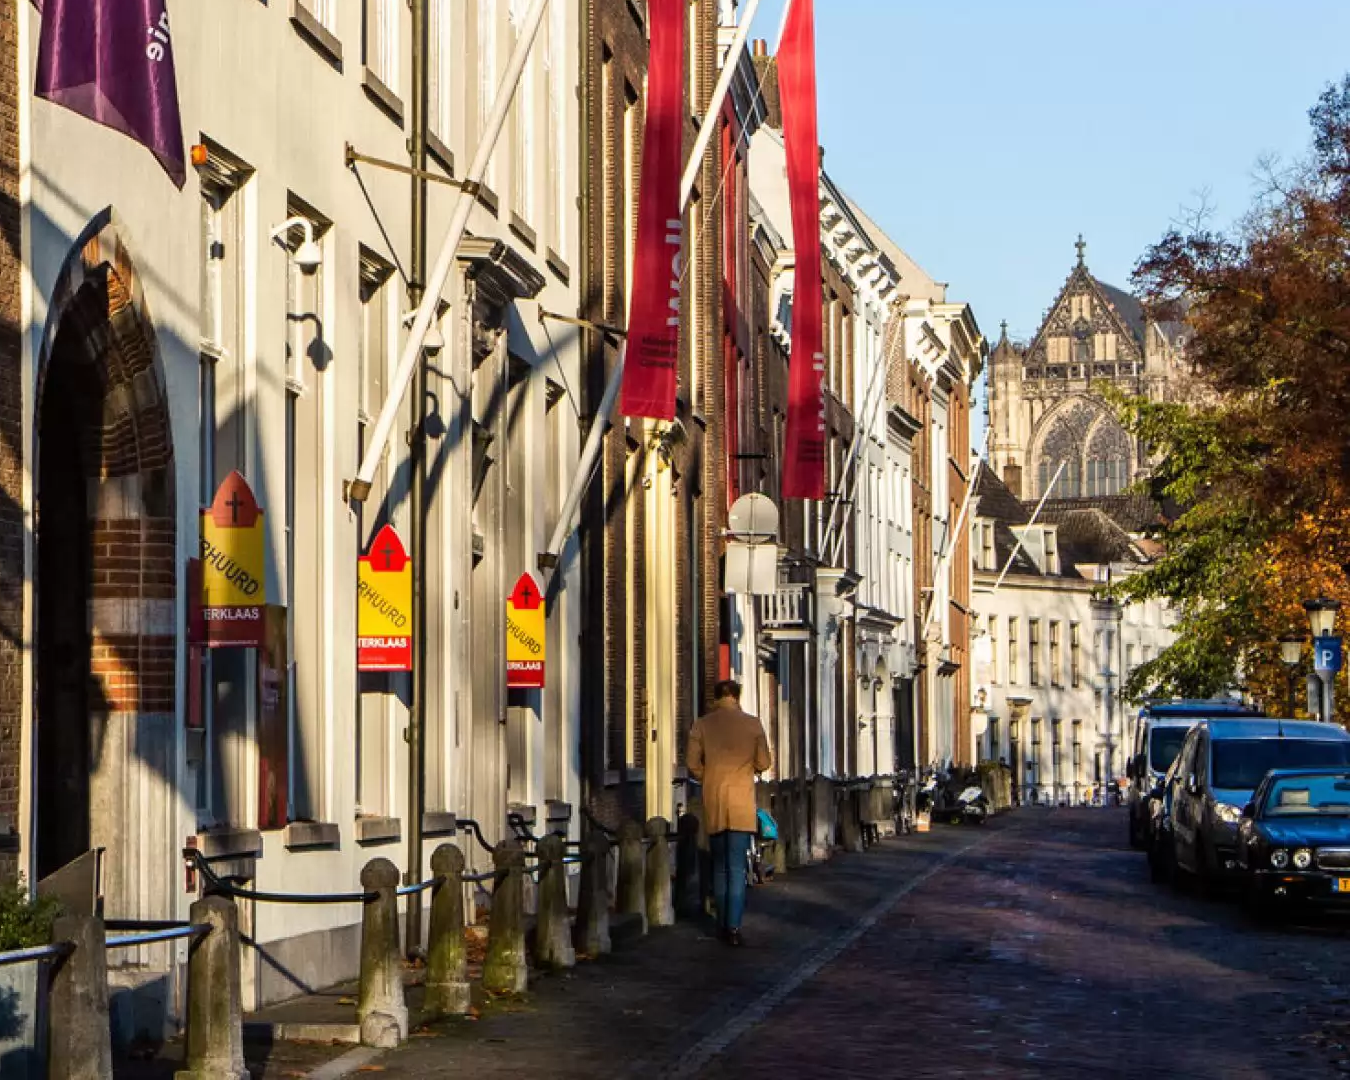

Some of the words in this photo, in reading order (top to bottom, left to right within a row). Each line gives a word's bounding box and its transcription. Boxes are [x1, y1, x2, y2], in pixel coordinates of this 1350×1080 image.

[199, 537, 259, 597] RHUURD
[202, 607, 260, 621] ERKLAAS
[358, 578, 407, 628] RHUURD
[1321, 650, 1334, 667] P
